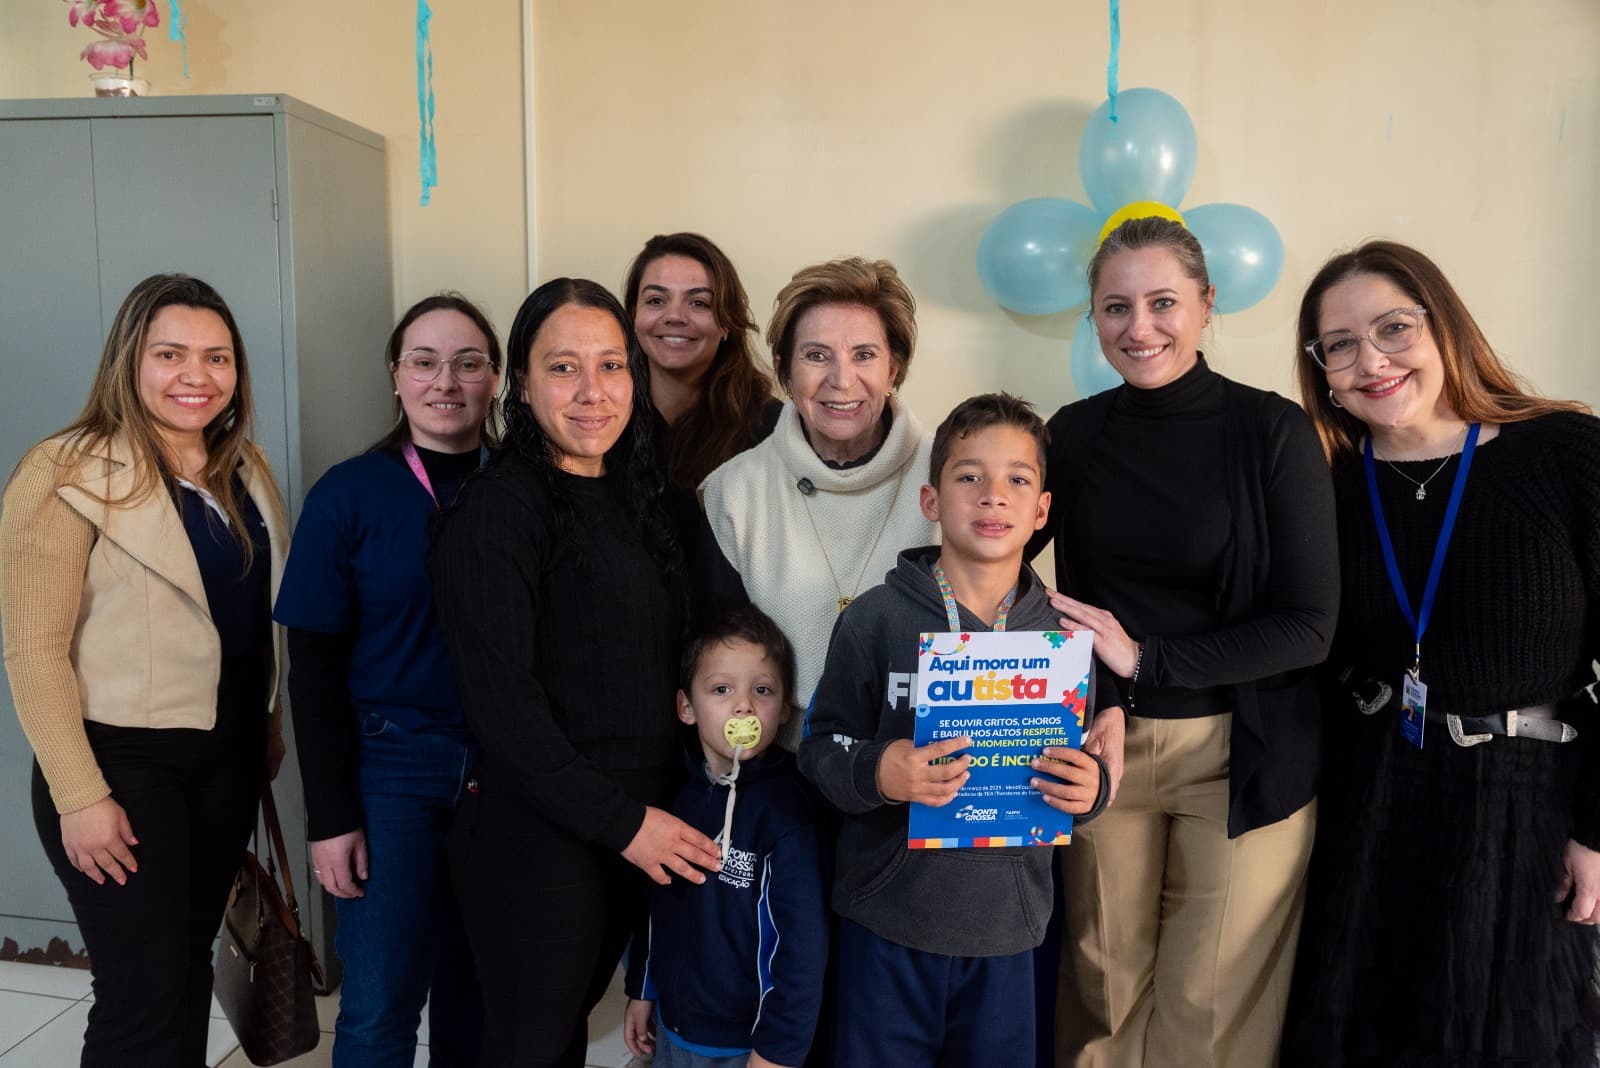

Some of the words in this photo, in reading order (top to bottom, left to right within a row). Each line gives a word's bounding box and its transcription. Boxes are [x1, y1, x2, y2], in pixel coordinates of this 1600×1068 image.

[929, 656, 970, 674] Aqui
[973, 658, 1018, 671] mora
[1022, 657, 1050, 669] um
[927, 671, 1048, 702] autista
[939, 719, 950, 728] SE
[952, 718, 983, 727] OUVIR
[984, 718, 1020, 727] GRITOS,
[1022, 716, 1062, 726] CHOROS
[932, 730, 939, 739] E
[940, 729, 991, 738] BARULHOS
[992, 728, 1022, 737] ALTOS
[1023, 727, 1066, 736] RESPEITE,
[977, 738, 1028, 748] MOMENTO
[1029, 738, 1042, 747] DE
[1043, 737, 1069, 746] CRISE
[991, 753, 1000, 767] É
